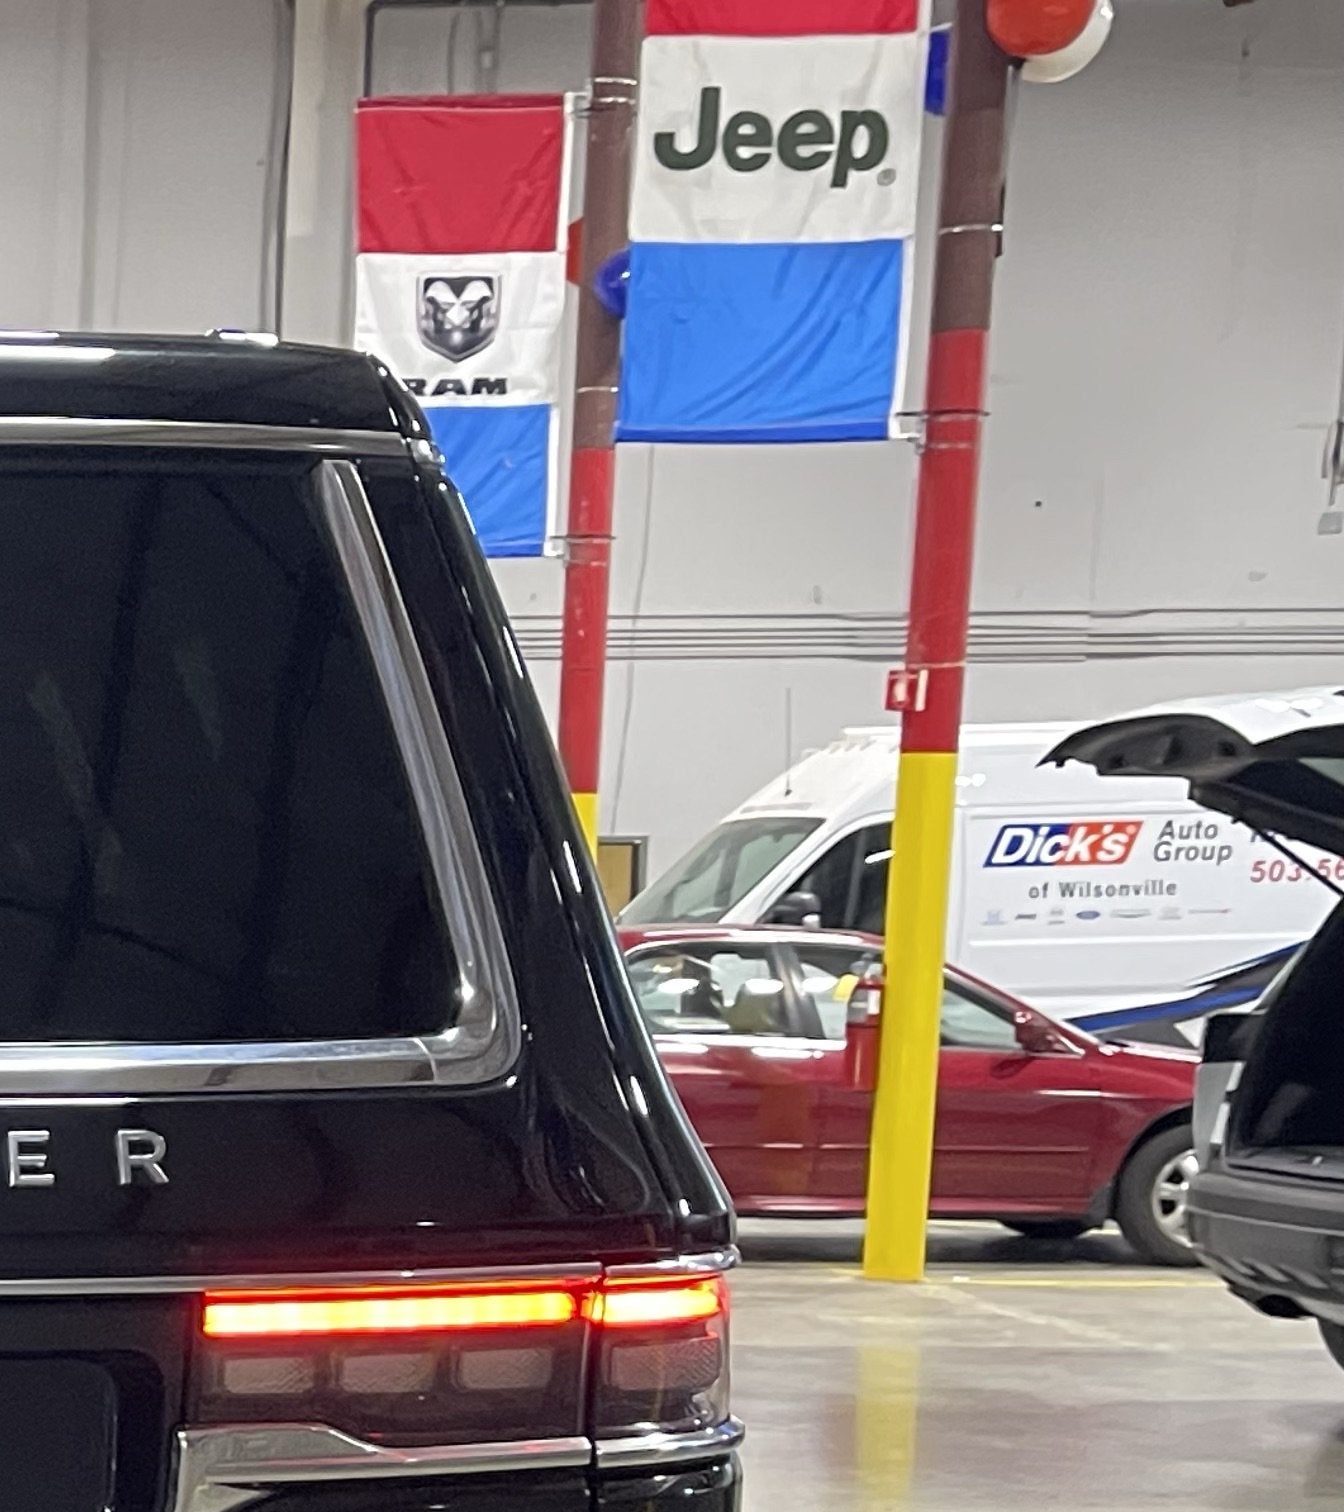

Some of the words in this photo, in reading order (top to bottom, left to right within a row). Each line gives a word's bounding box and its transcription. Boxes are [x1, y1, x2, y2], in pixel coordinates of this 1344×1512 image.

[654, 86, 889, 188] Jeep
[401, 377, 508, 396] RAM
[1157, 820, 1219, 841] Auto
[991, 825, 1130, 864] Dick's
[1153, 841, 1234, 867] Group
[1028, 882, 1050, 899] of
[1058, 879, 1177, 898] Wilsonville
